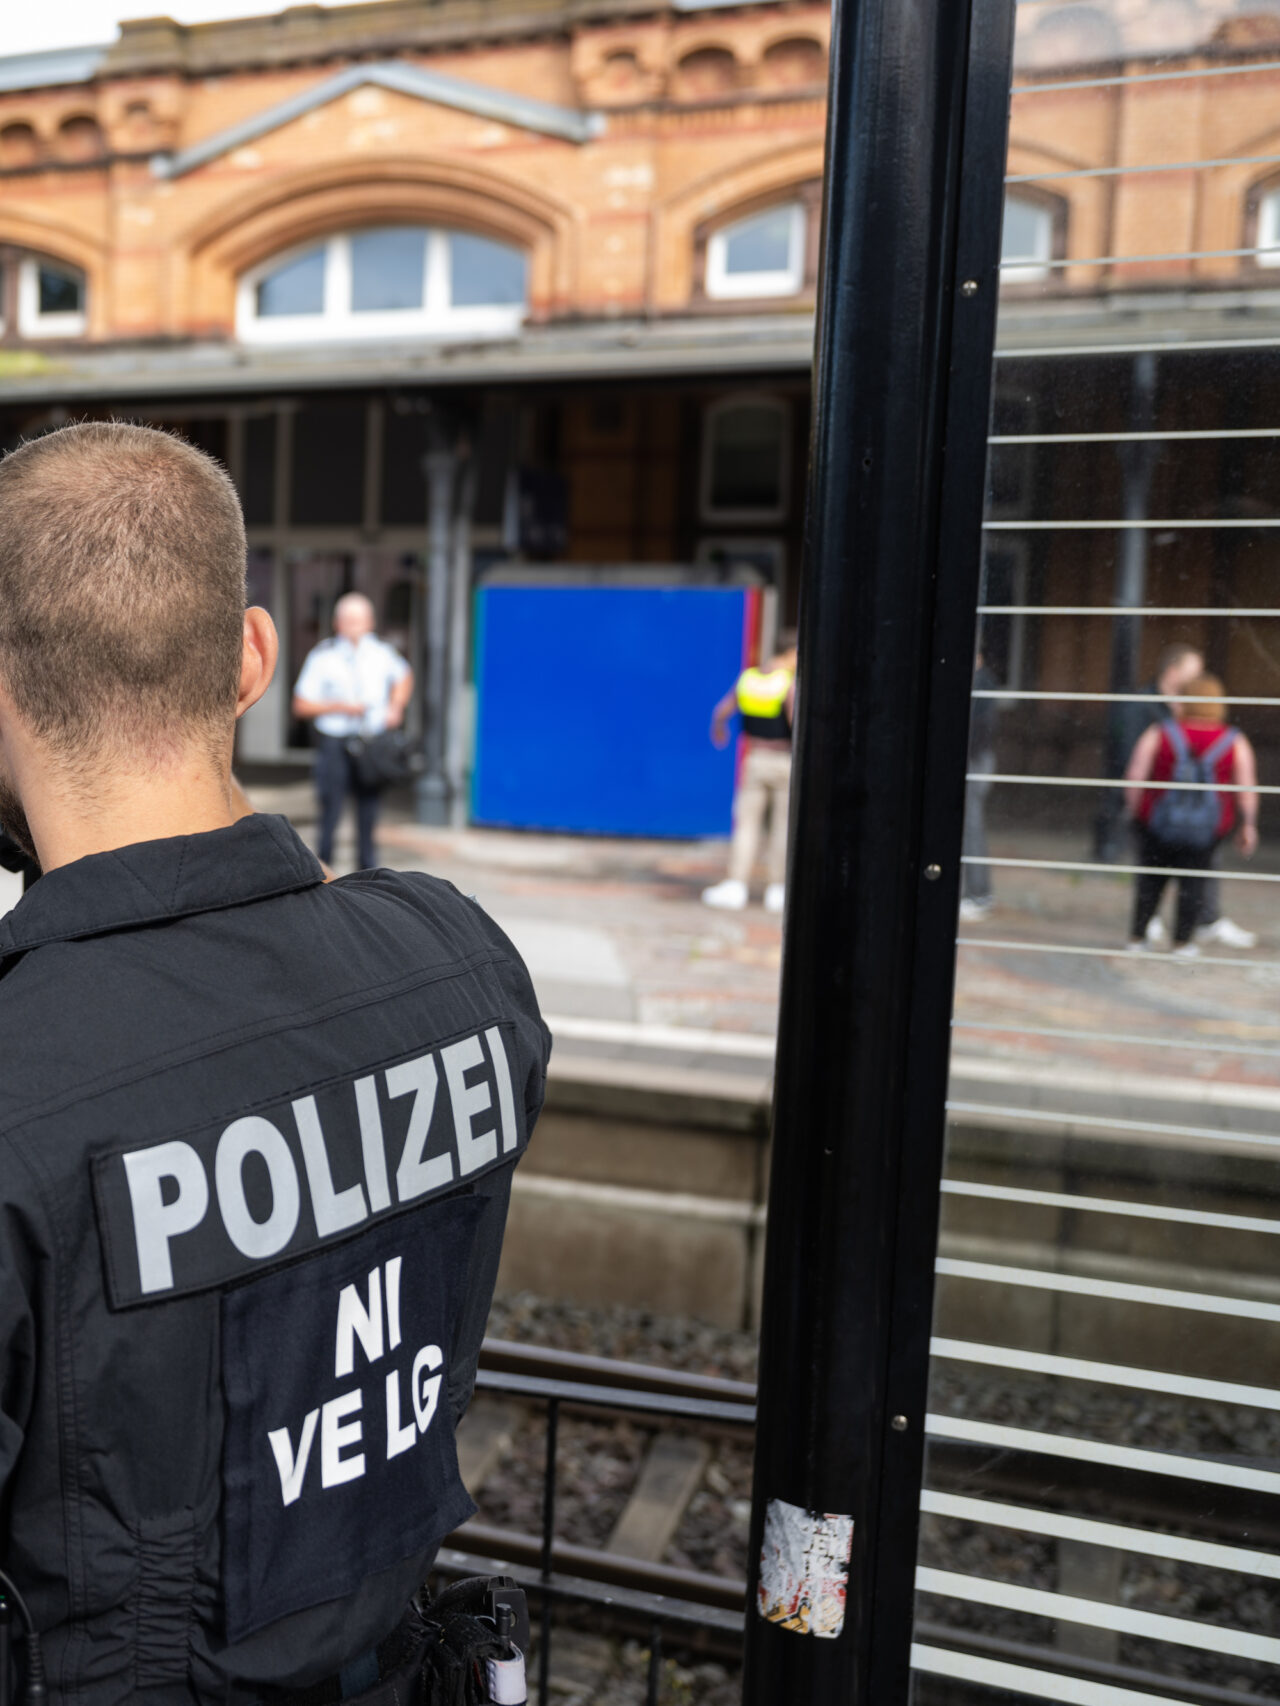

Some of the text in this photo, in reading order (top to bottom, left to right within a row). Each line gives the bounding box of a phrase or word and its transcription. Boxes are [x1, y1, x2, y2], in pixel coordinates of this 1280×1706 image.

[123, 1025, 518, 1295] POLIZEI
[335, 1256, 402, 1378] NI
[267, 1344, 444, 1507] VE LG
